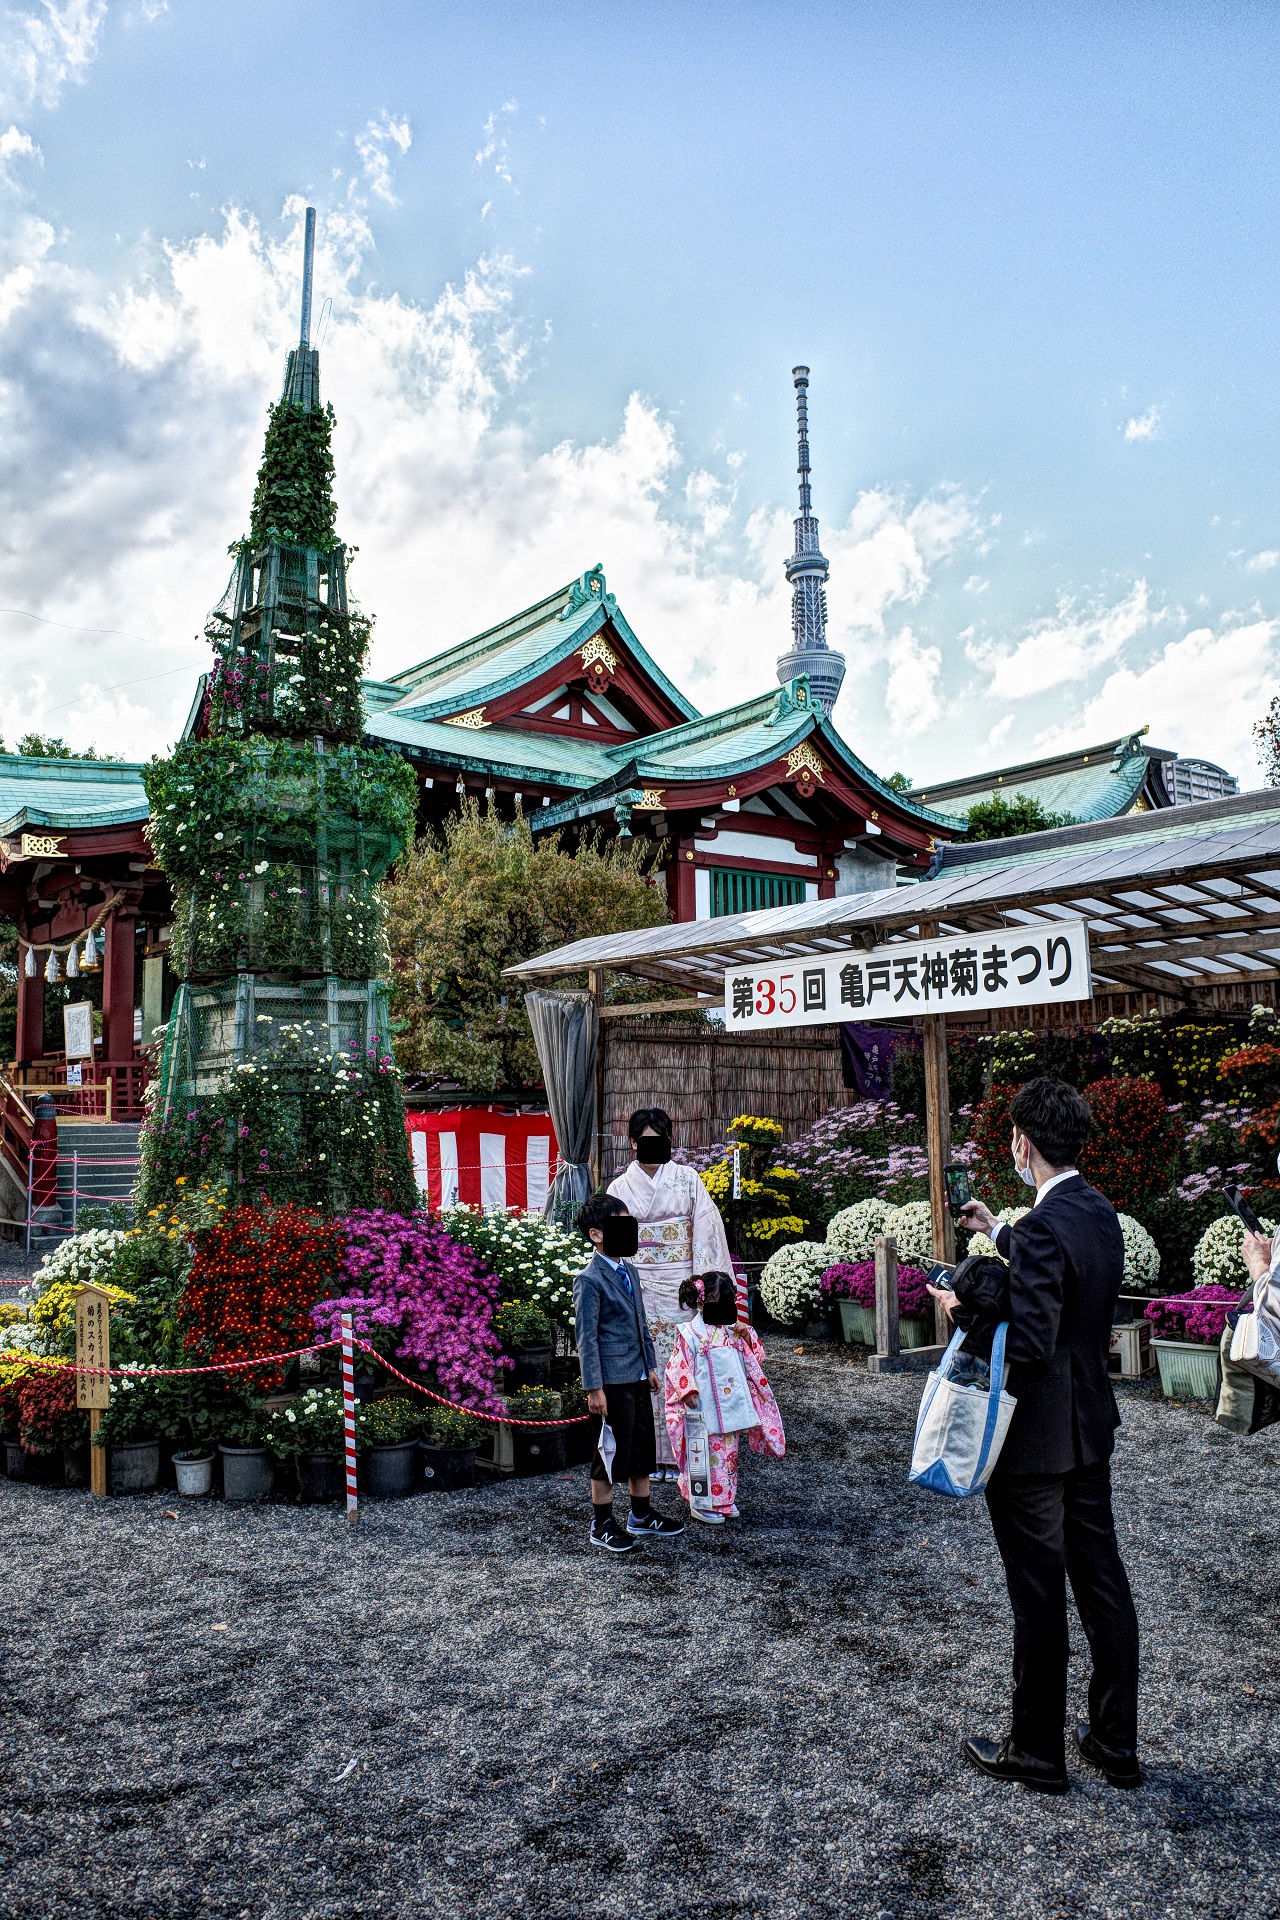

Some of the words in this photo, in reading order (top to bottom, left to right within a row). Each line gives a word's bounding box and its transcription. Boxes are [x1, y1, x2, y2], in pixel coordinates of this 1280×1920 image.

[731, 967, 826, 1019] 第35回
[839, 936, 1073, 1009] 亀戸天神菊まつり
[650, 1519, 664, 1530] N
[600, 1531, 614, 1543] N
